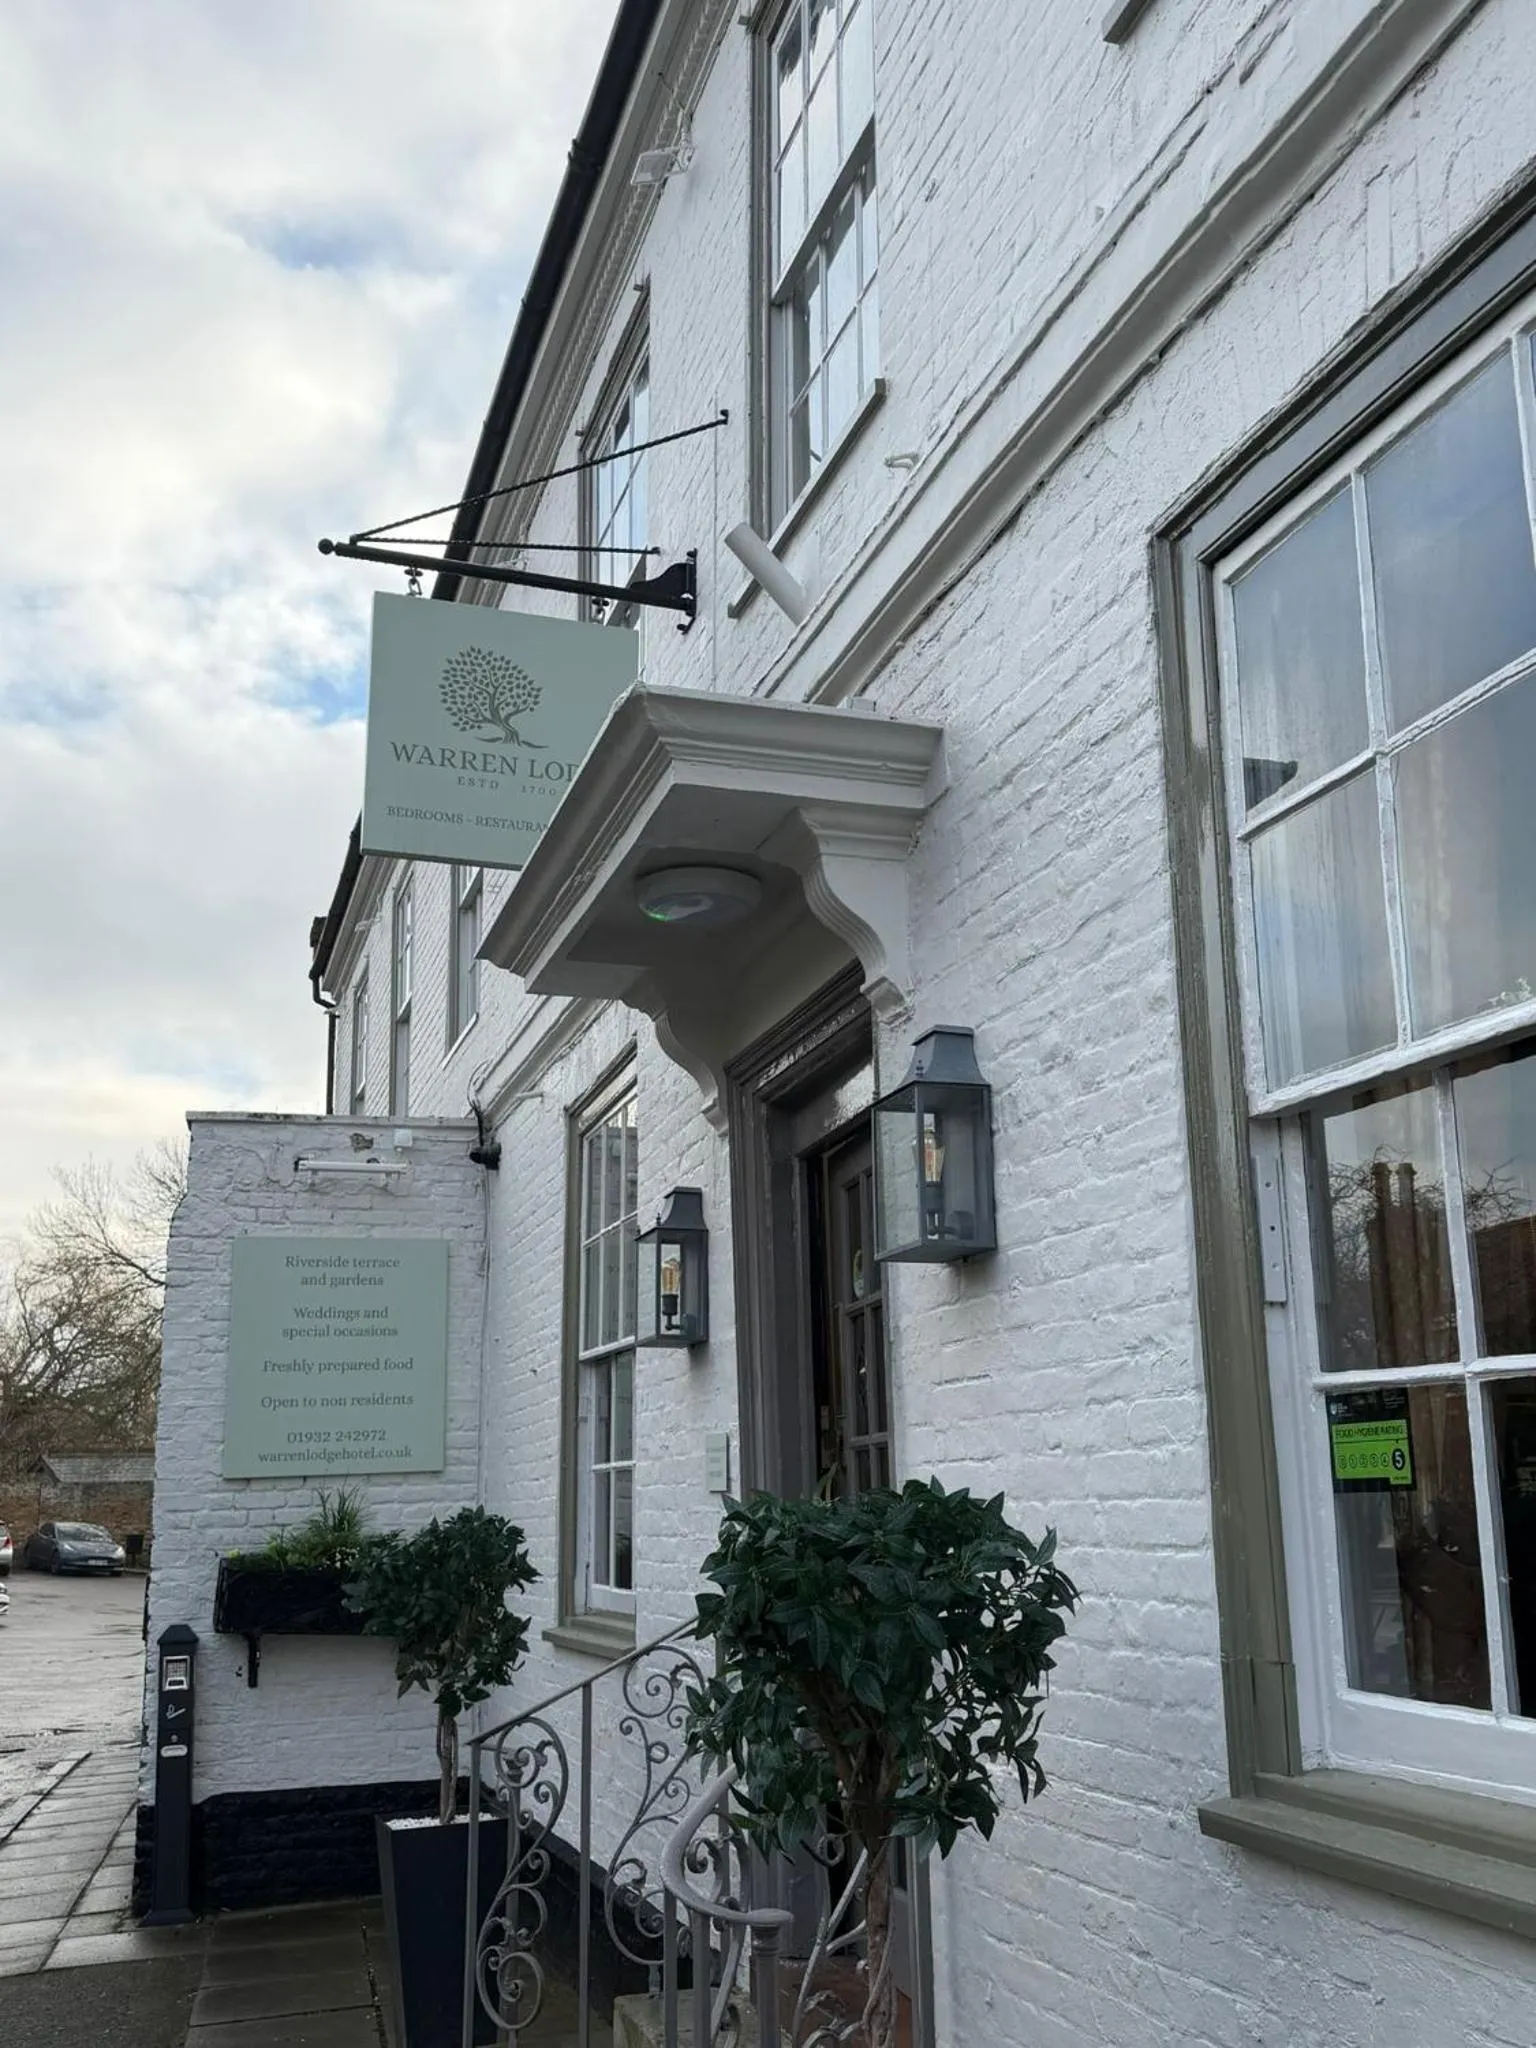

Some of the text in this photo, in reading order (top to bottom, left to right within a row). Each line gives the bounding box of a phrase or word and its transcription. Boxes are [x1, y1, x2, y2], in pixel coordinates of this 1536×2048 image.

[390, 741, 519, 777] WARREN
[457, 775, 557, 797] ESTD 1700
[387, 805, 464, 824] BEDROOMS
[285, 1255, 401, 1269] Riverside terrace
[301, 1272, 384, 1288] and gardens
[293, 1306, 389, 1321] Weddings and
[281, 1325, 399, 1340] special occasions
[263, 1357, 414, 1375] Freshly prepared food
[260, 1392, 415, 1411] Open to non residents
[287, 1429, 387, 1444] 01932 242972
[258, 1445, 413, 1464] warrenlodgehotel.co.uk
